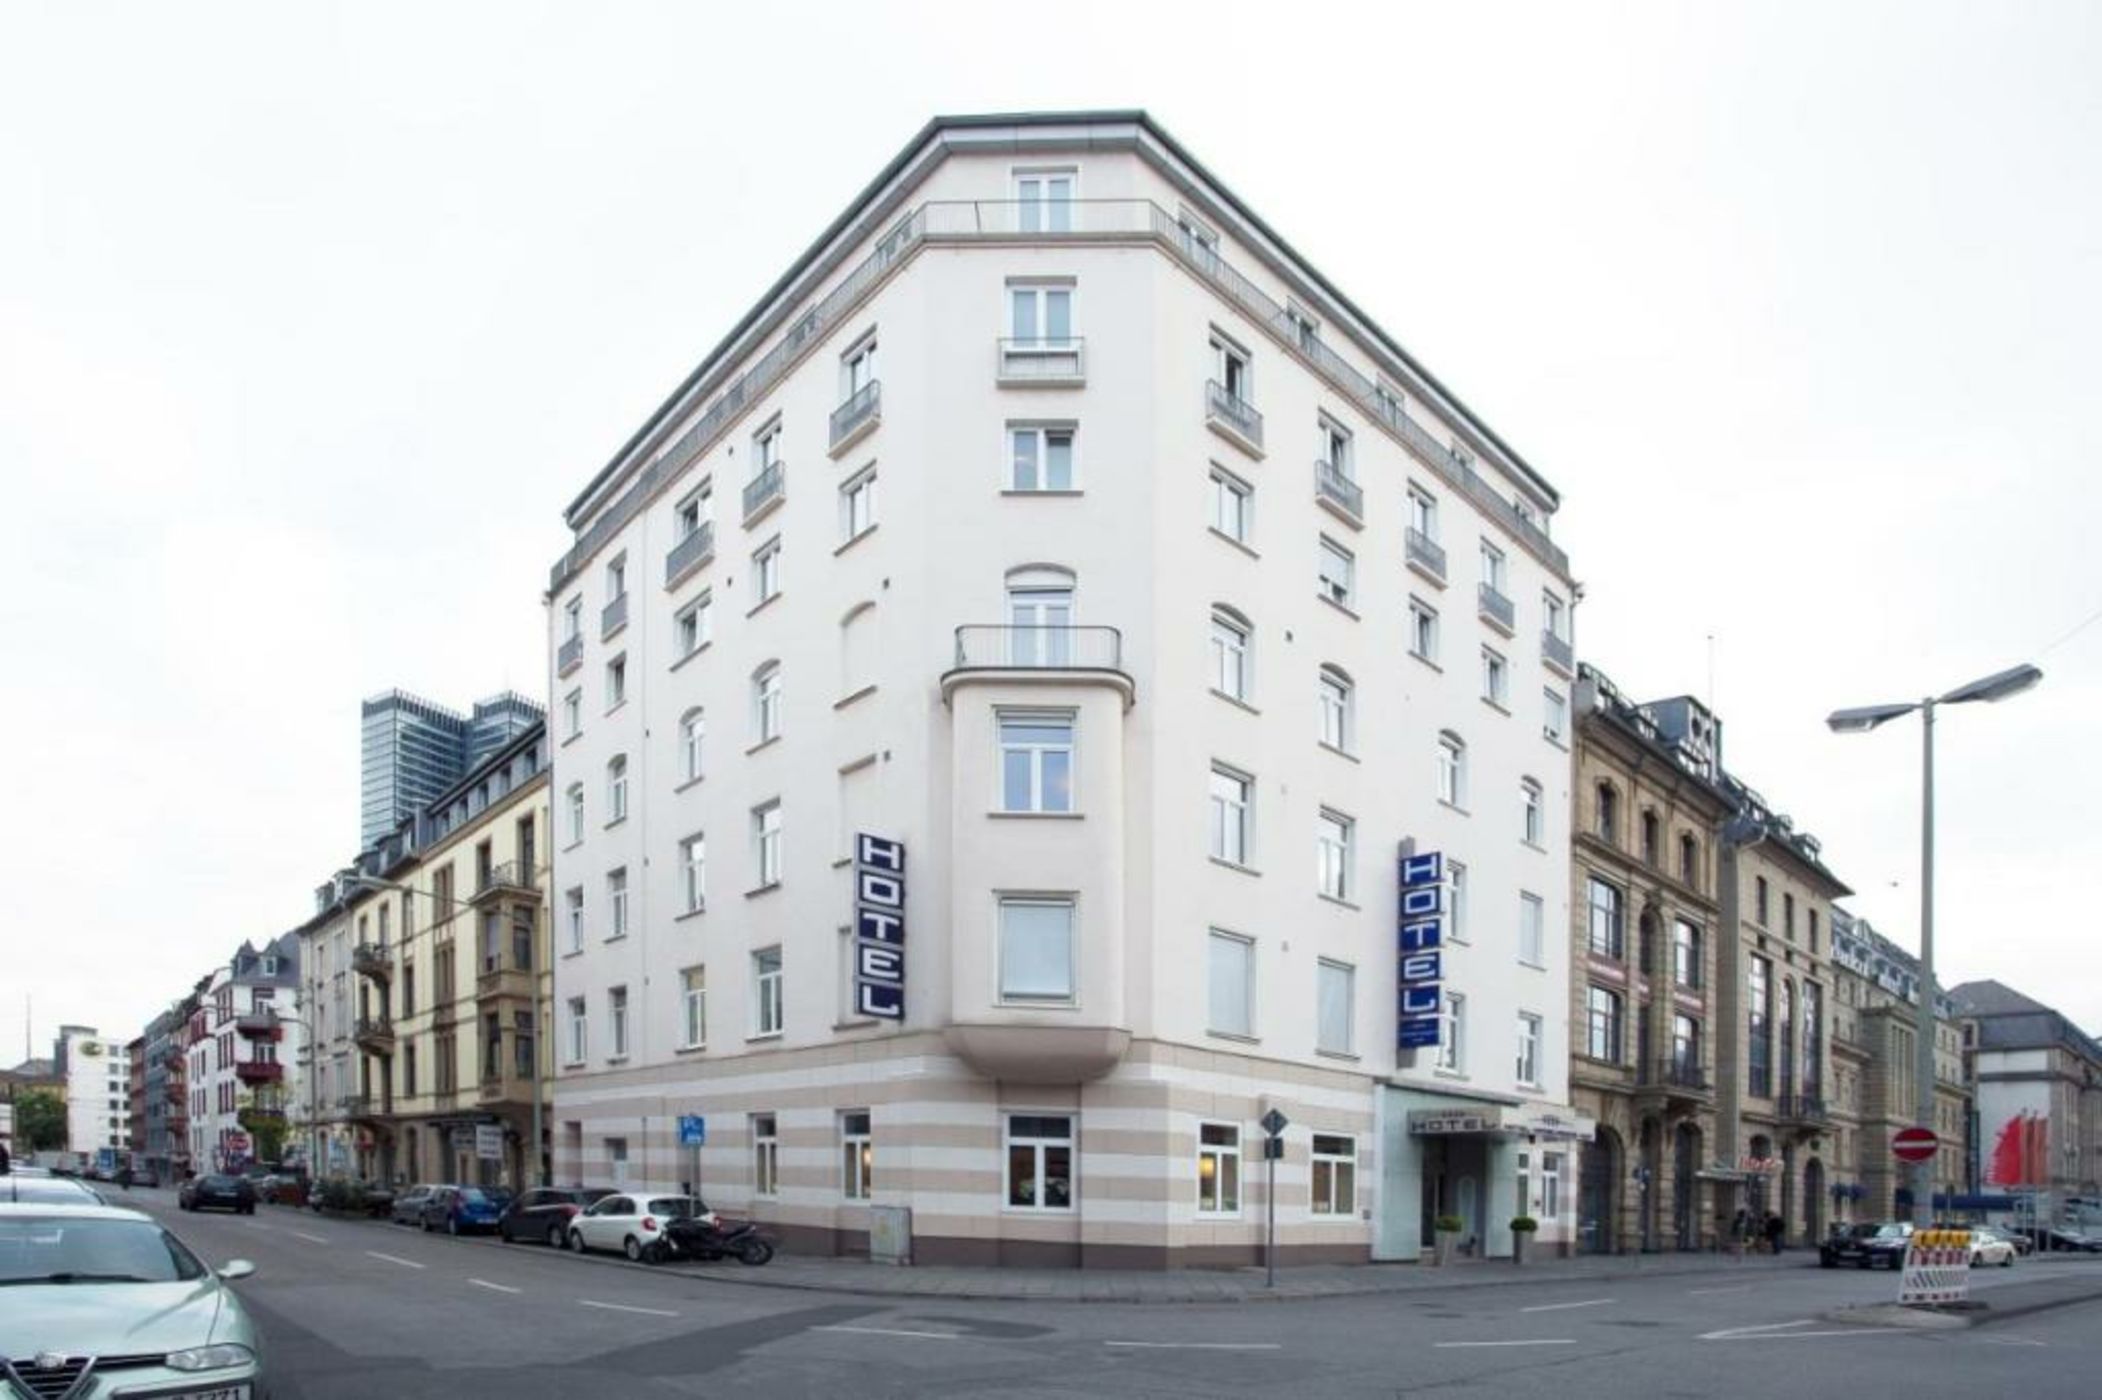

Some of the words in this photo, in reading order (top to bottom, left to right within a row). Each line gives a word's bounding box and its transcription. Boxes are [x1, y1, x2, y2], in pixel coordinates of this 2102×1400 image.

[862, 836, 900, 1016] HOTEL
[1404, 855, 1437, 1013] HOTEL
[1412, 1118, 1497, 1132] HOTEL
